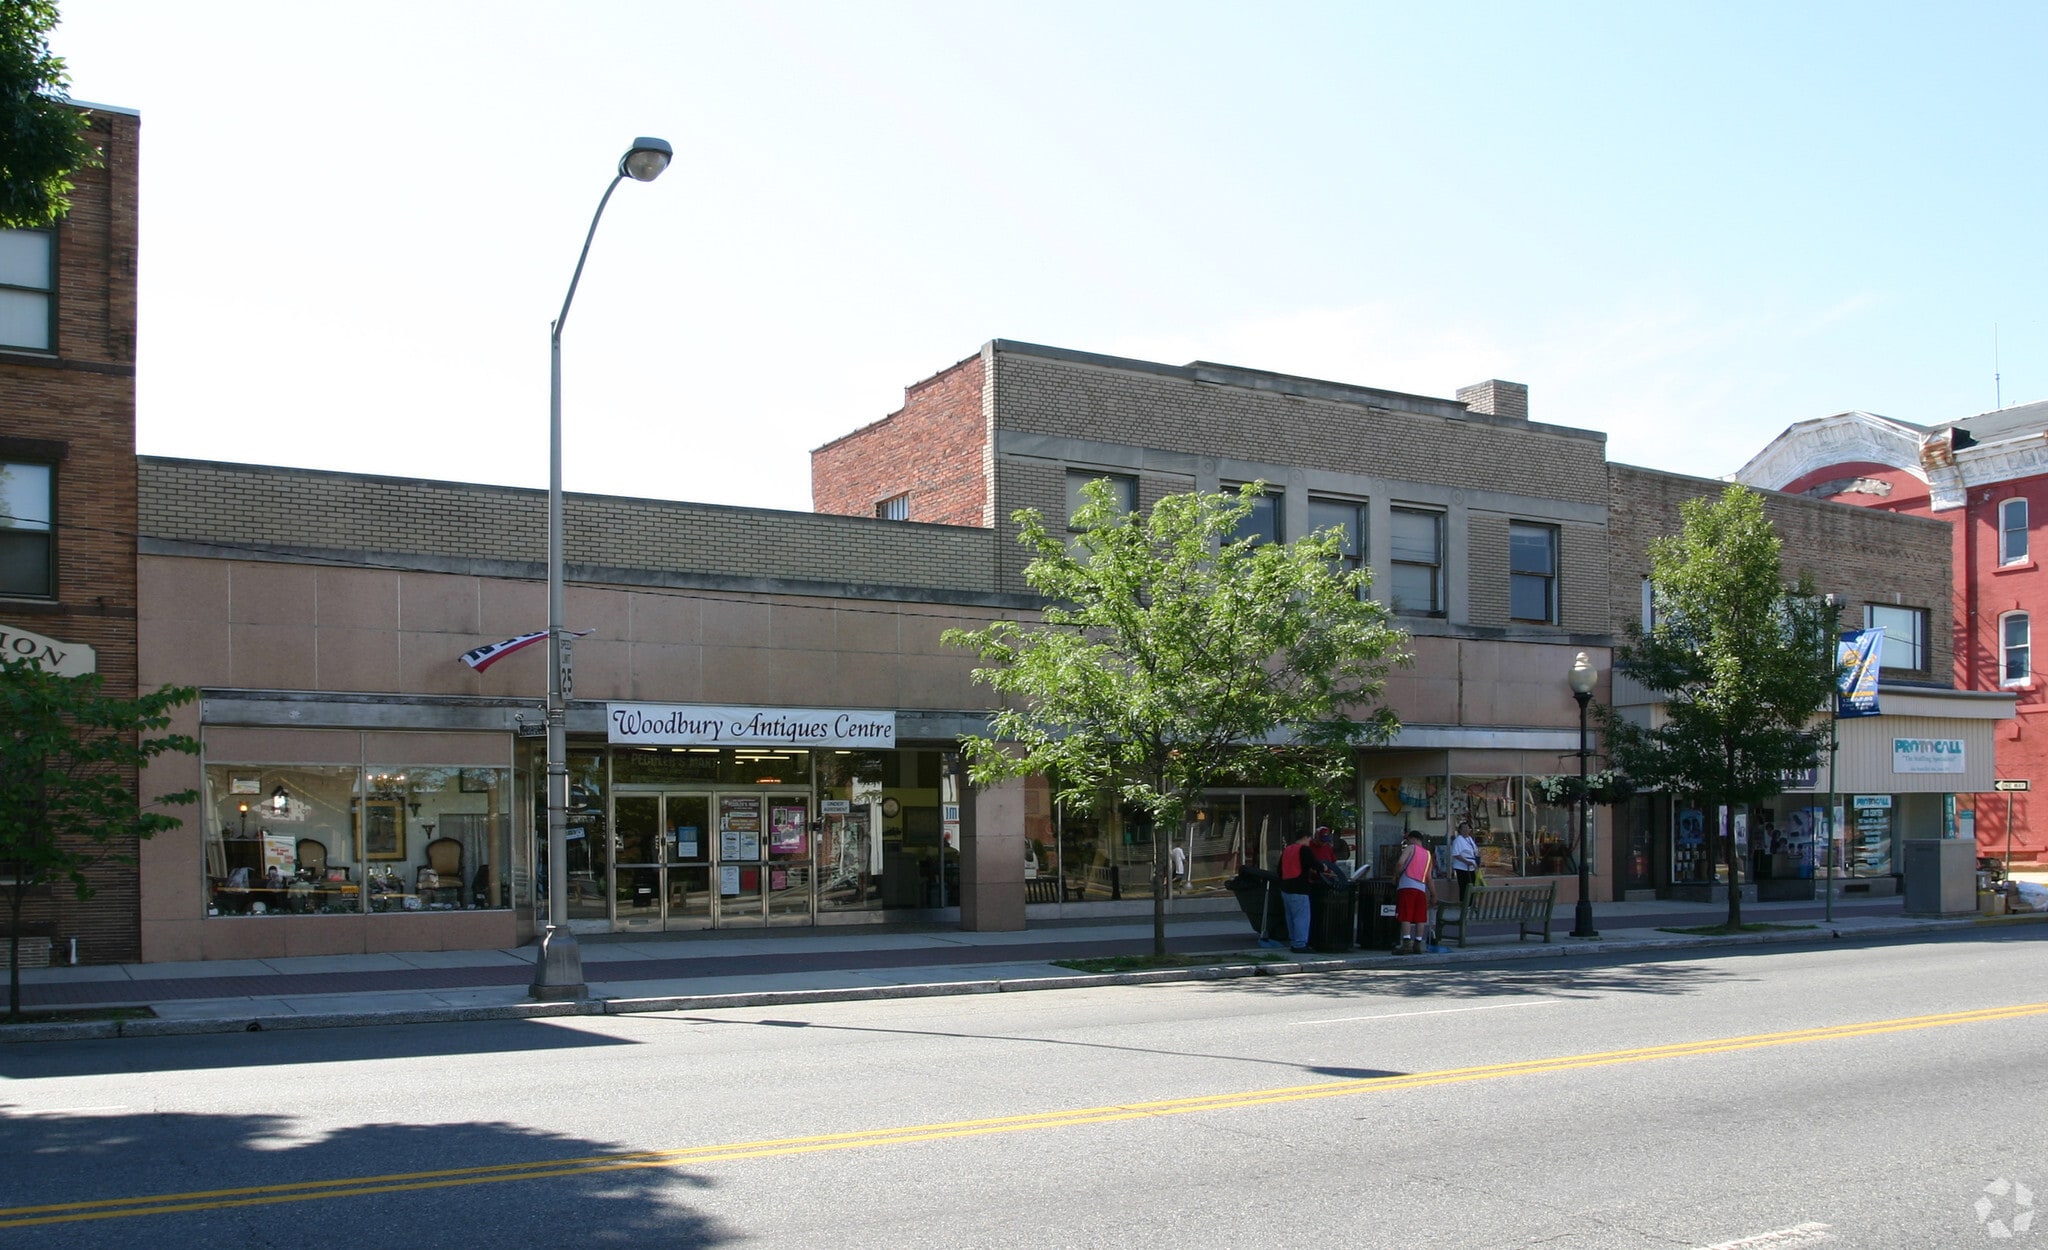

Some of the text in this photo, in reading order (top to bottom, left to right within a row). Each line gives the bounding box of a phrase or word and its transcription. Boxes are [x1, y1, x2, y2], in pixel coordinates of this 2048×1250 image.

[561, 667, 573, 693] 25
[613, 710, 892, 742] Woodbury Antiques Centre
[1895, 740, 1962, 754] PROTOCALL
